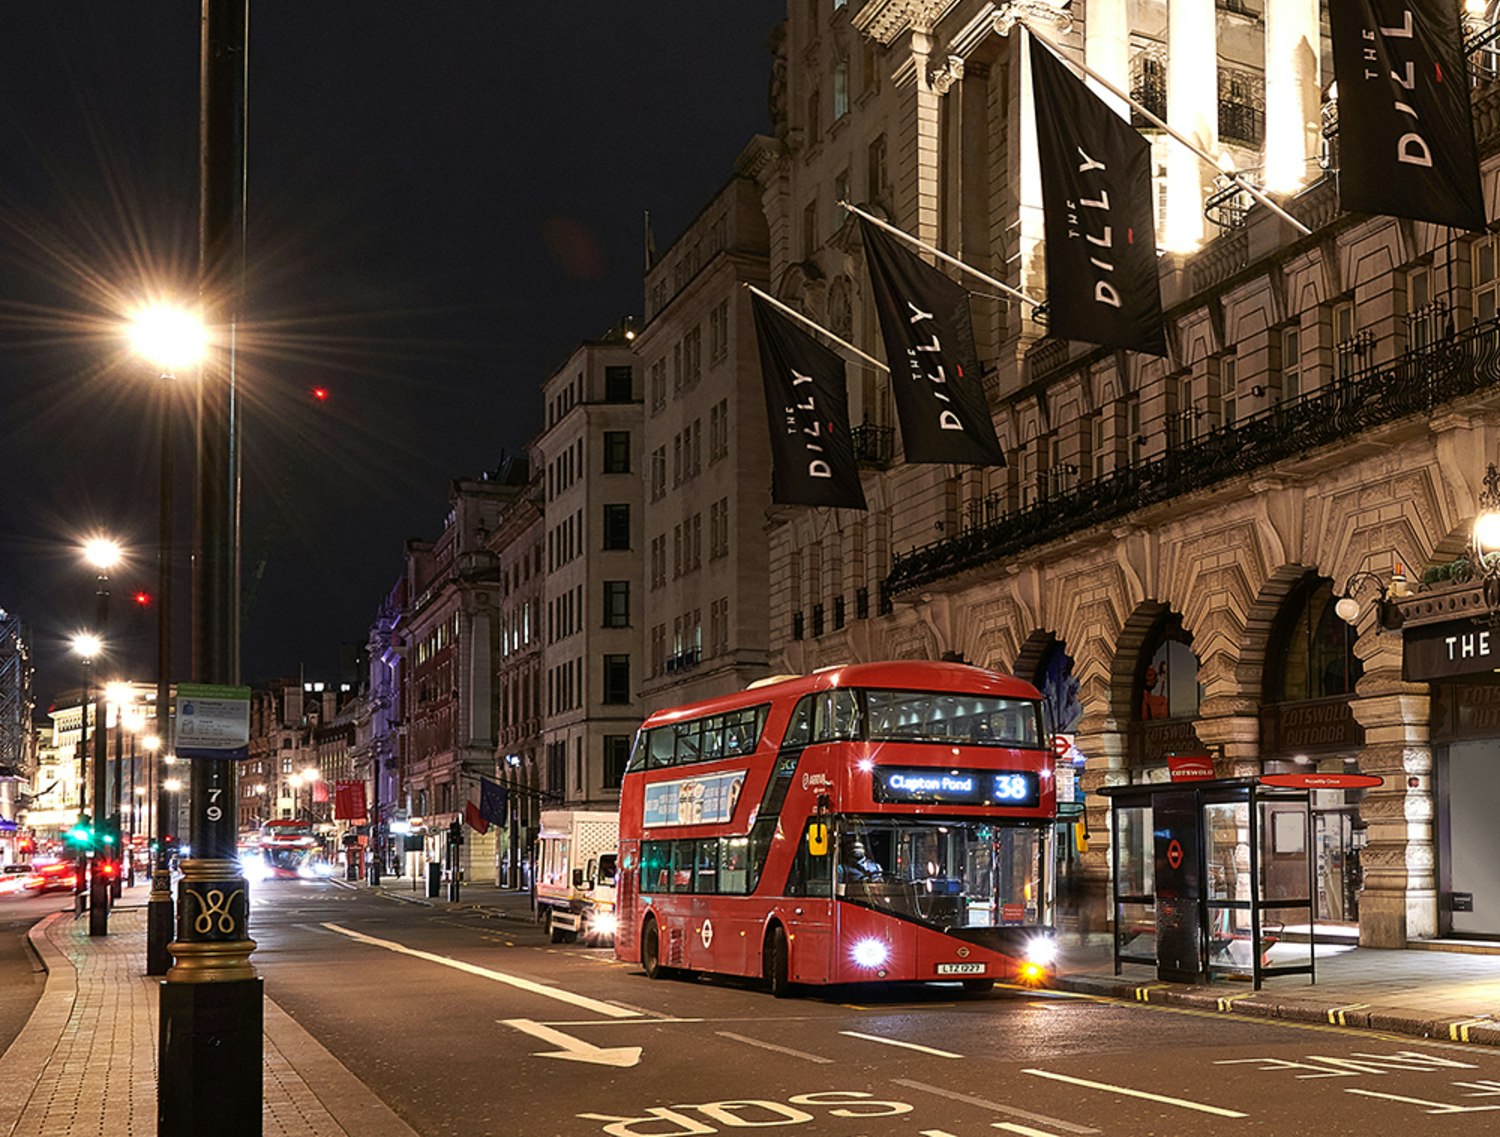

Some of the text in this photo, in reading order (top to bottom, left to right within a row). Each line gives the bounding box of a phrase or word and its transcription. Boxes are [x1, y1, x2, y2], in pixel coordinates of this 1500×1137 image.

[1362, 29, 1378, 80] THE
[1066, 199, 1080, 238] THE
[1077, 146, 1122, 308] DILLY
[907, 348, 922, 380] THE
[908, 301, 964, 431] DILLY
[785, 406, 797, 434] THE
[790, 368, 832, 477] DILLY
[1445, 631, 1491, 660] THE
[1282, 705, 1350, 727] COTSWOLD
[1147, 724, 1196, 741] COTSWOL
[1286, 725, 1345, 746] OUTDOOR
[890, 775, 1026, 799] Clapton Pond 38
